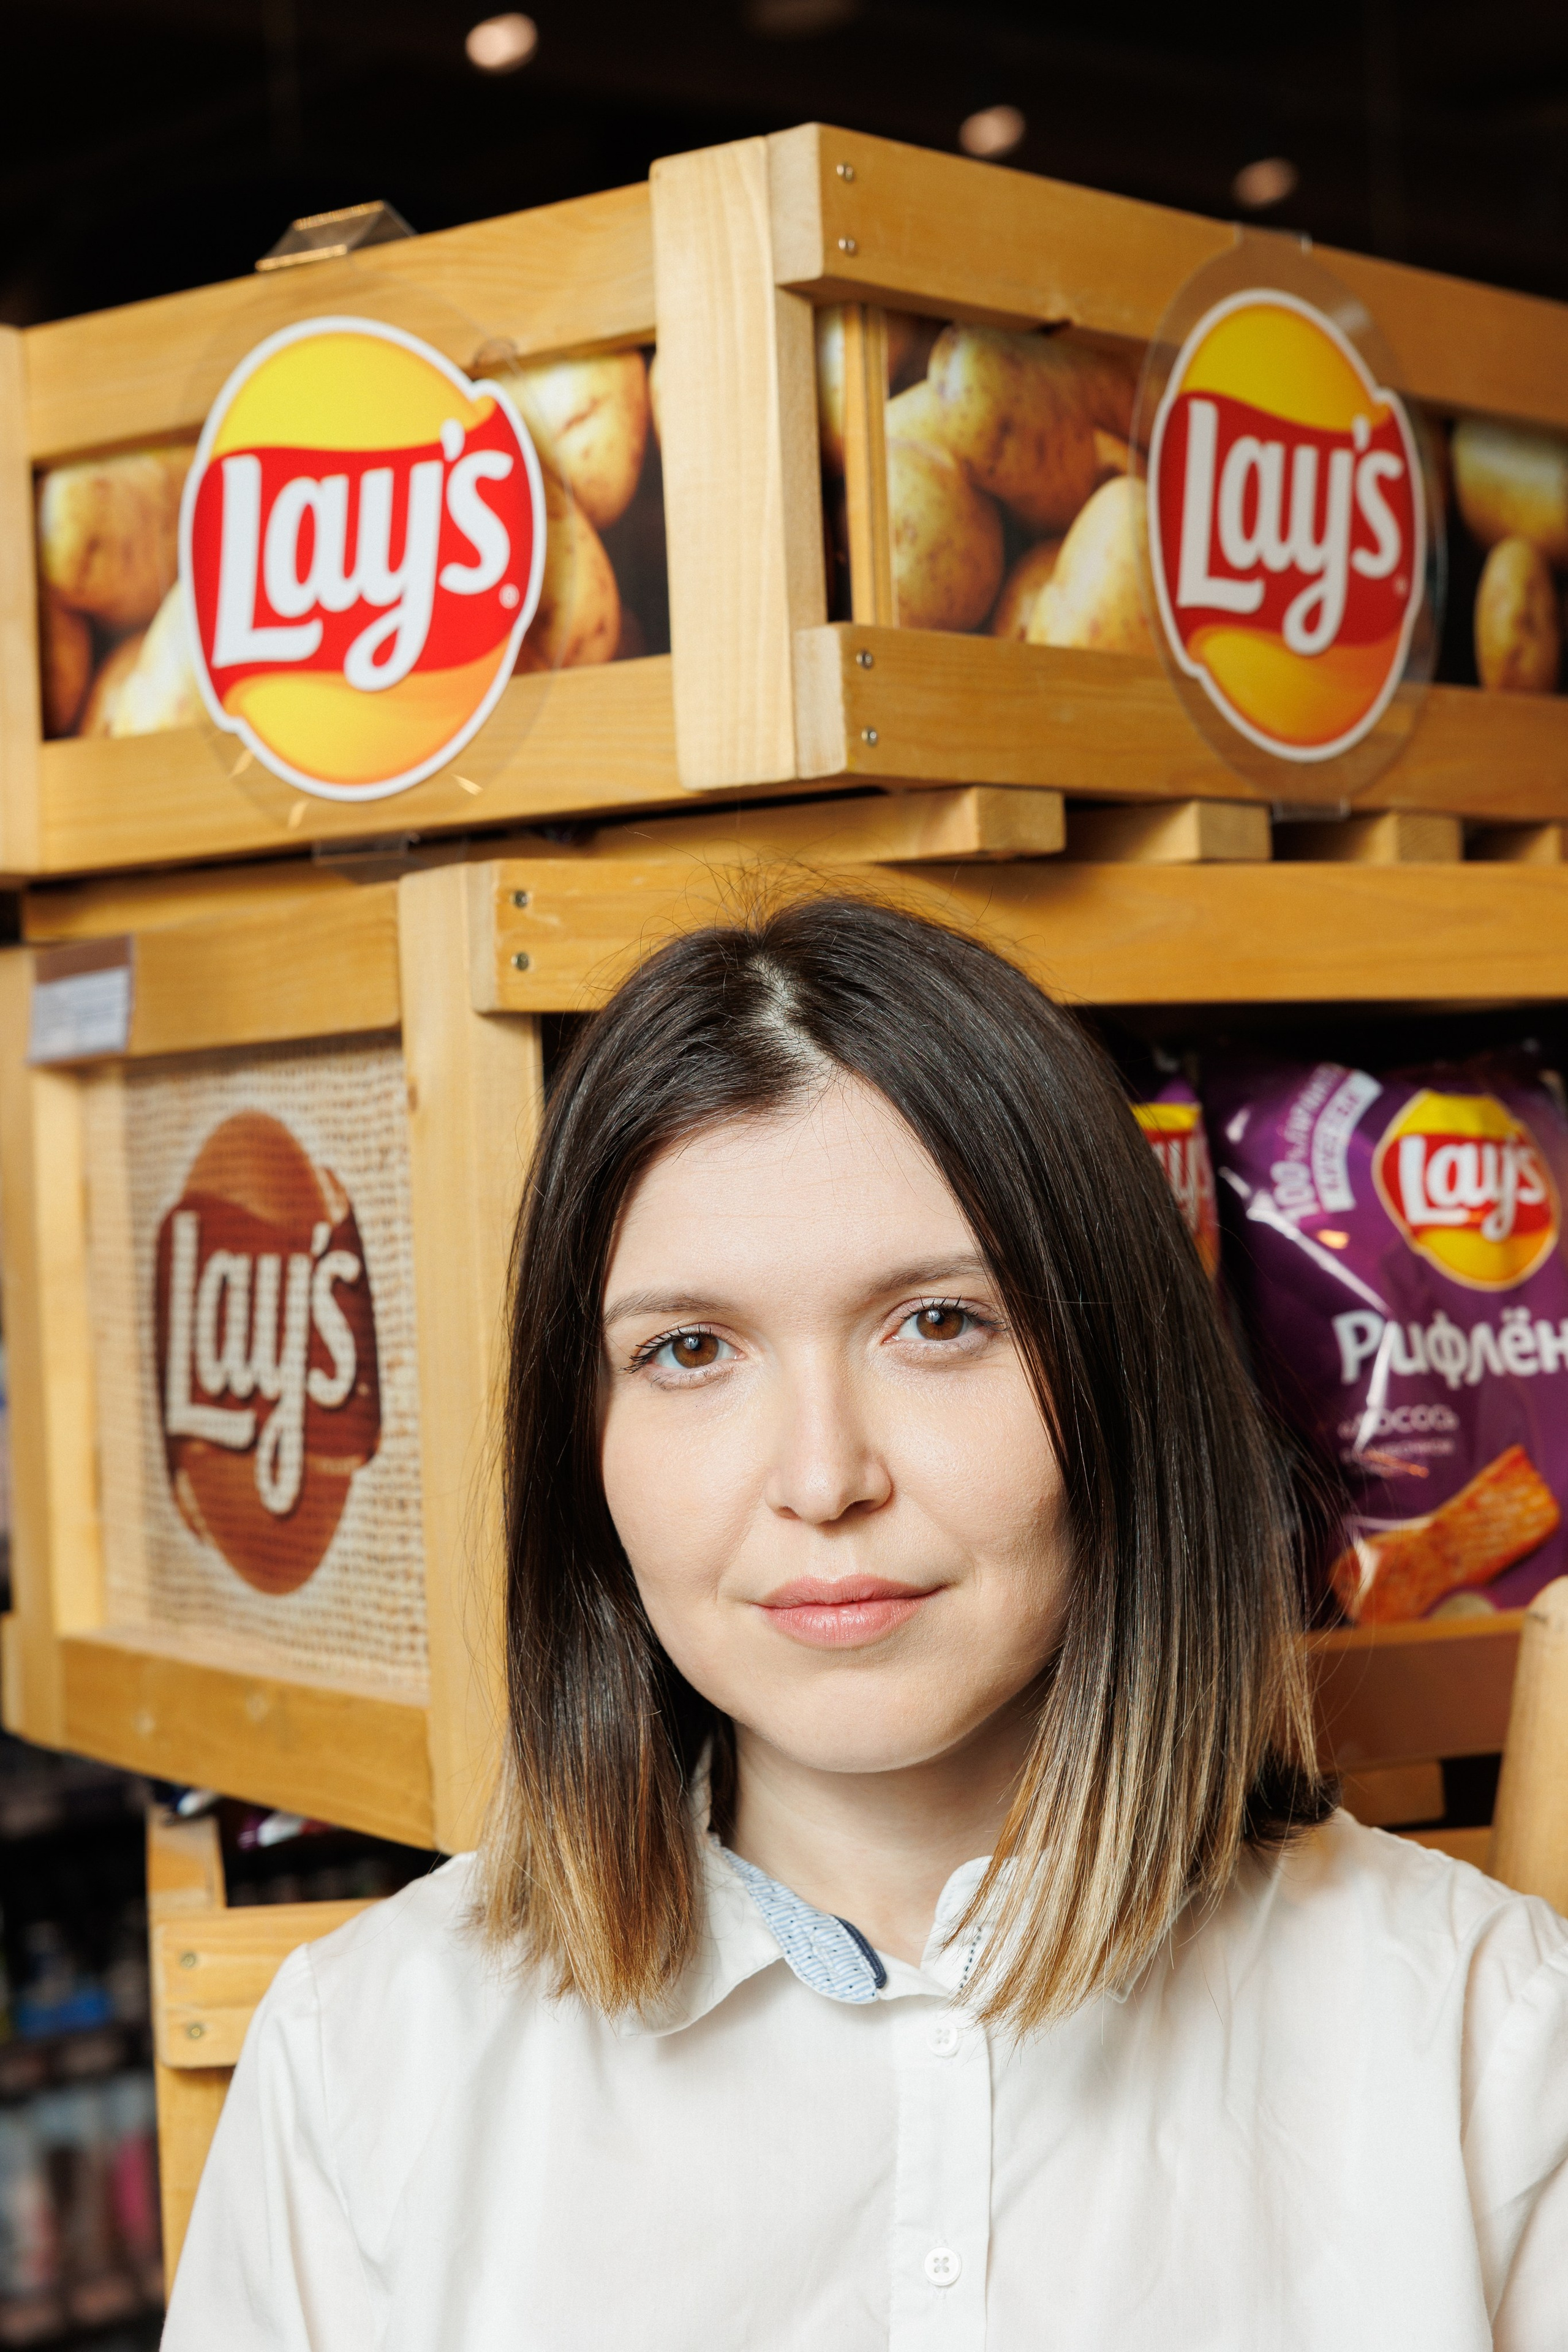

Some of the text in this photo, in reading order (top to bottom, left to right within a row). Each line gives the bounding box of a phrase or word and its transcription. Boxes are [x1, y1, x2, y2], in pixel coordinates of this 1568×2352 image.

[212, 418, 514, 692] Lay's
[1176, 415, 1404, 655] Lay's
[1398, 1132, 1546, 1243] Lay's
[165, 1210, 361, 1514] Lay's
